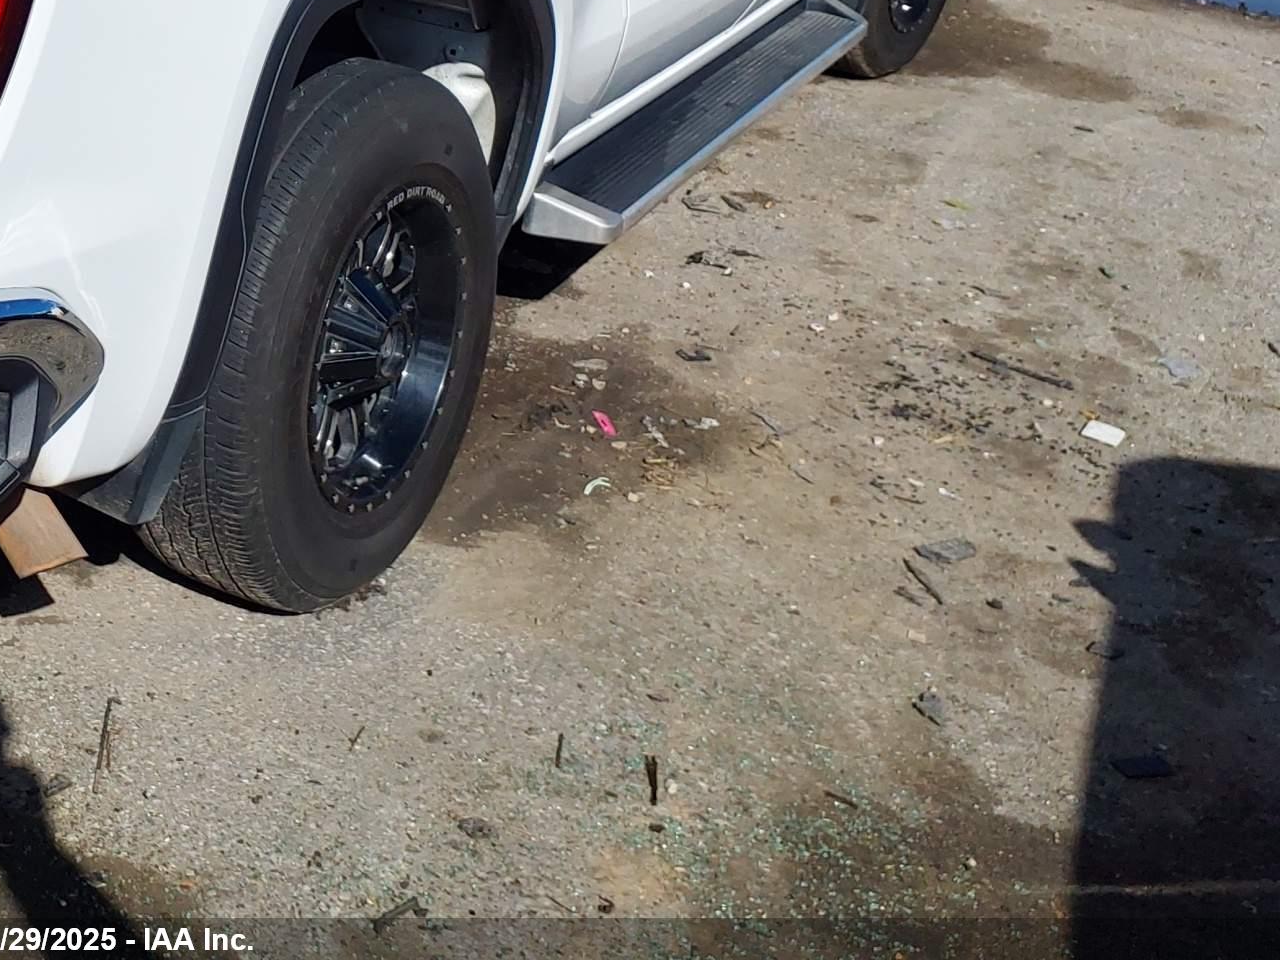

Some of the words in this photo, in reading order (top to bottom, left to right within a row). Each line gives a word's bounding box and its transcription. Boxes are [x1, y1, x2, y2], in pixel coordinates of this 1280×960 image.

[386, 191, 405, 211] RED
[406, 186, 426, 200] DIRT
[426, 186, 447, 205] ROAD
